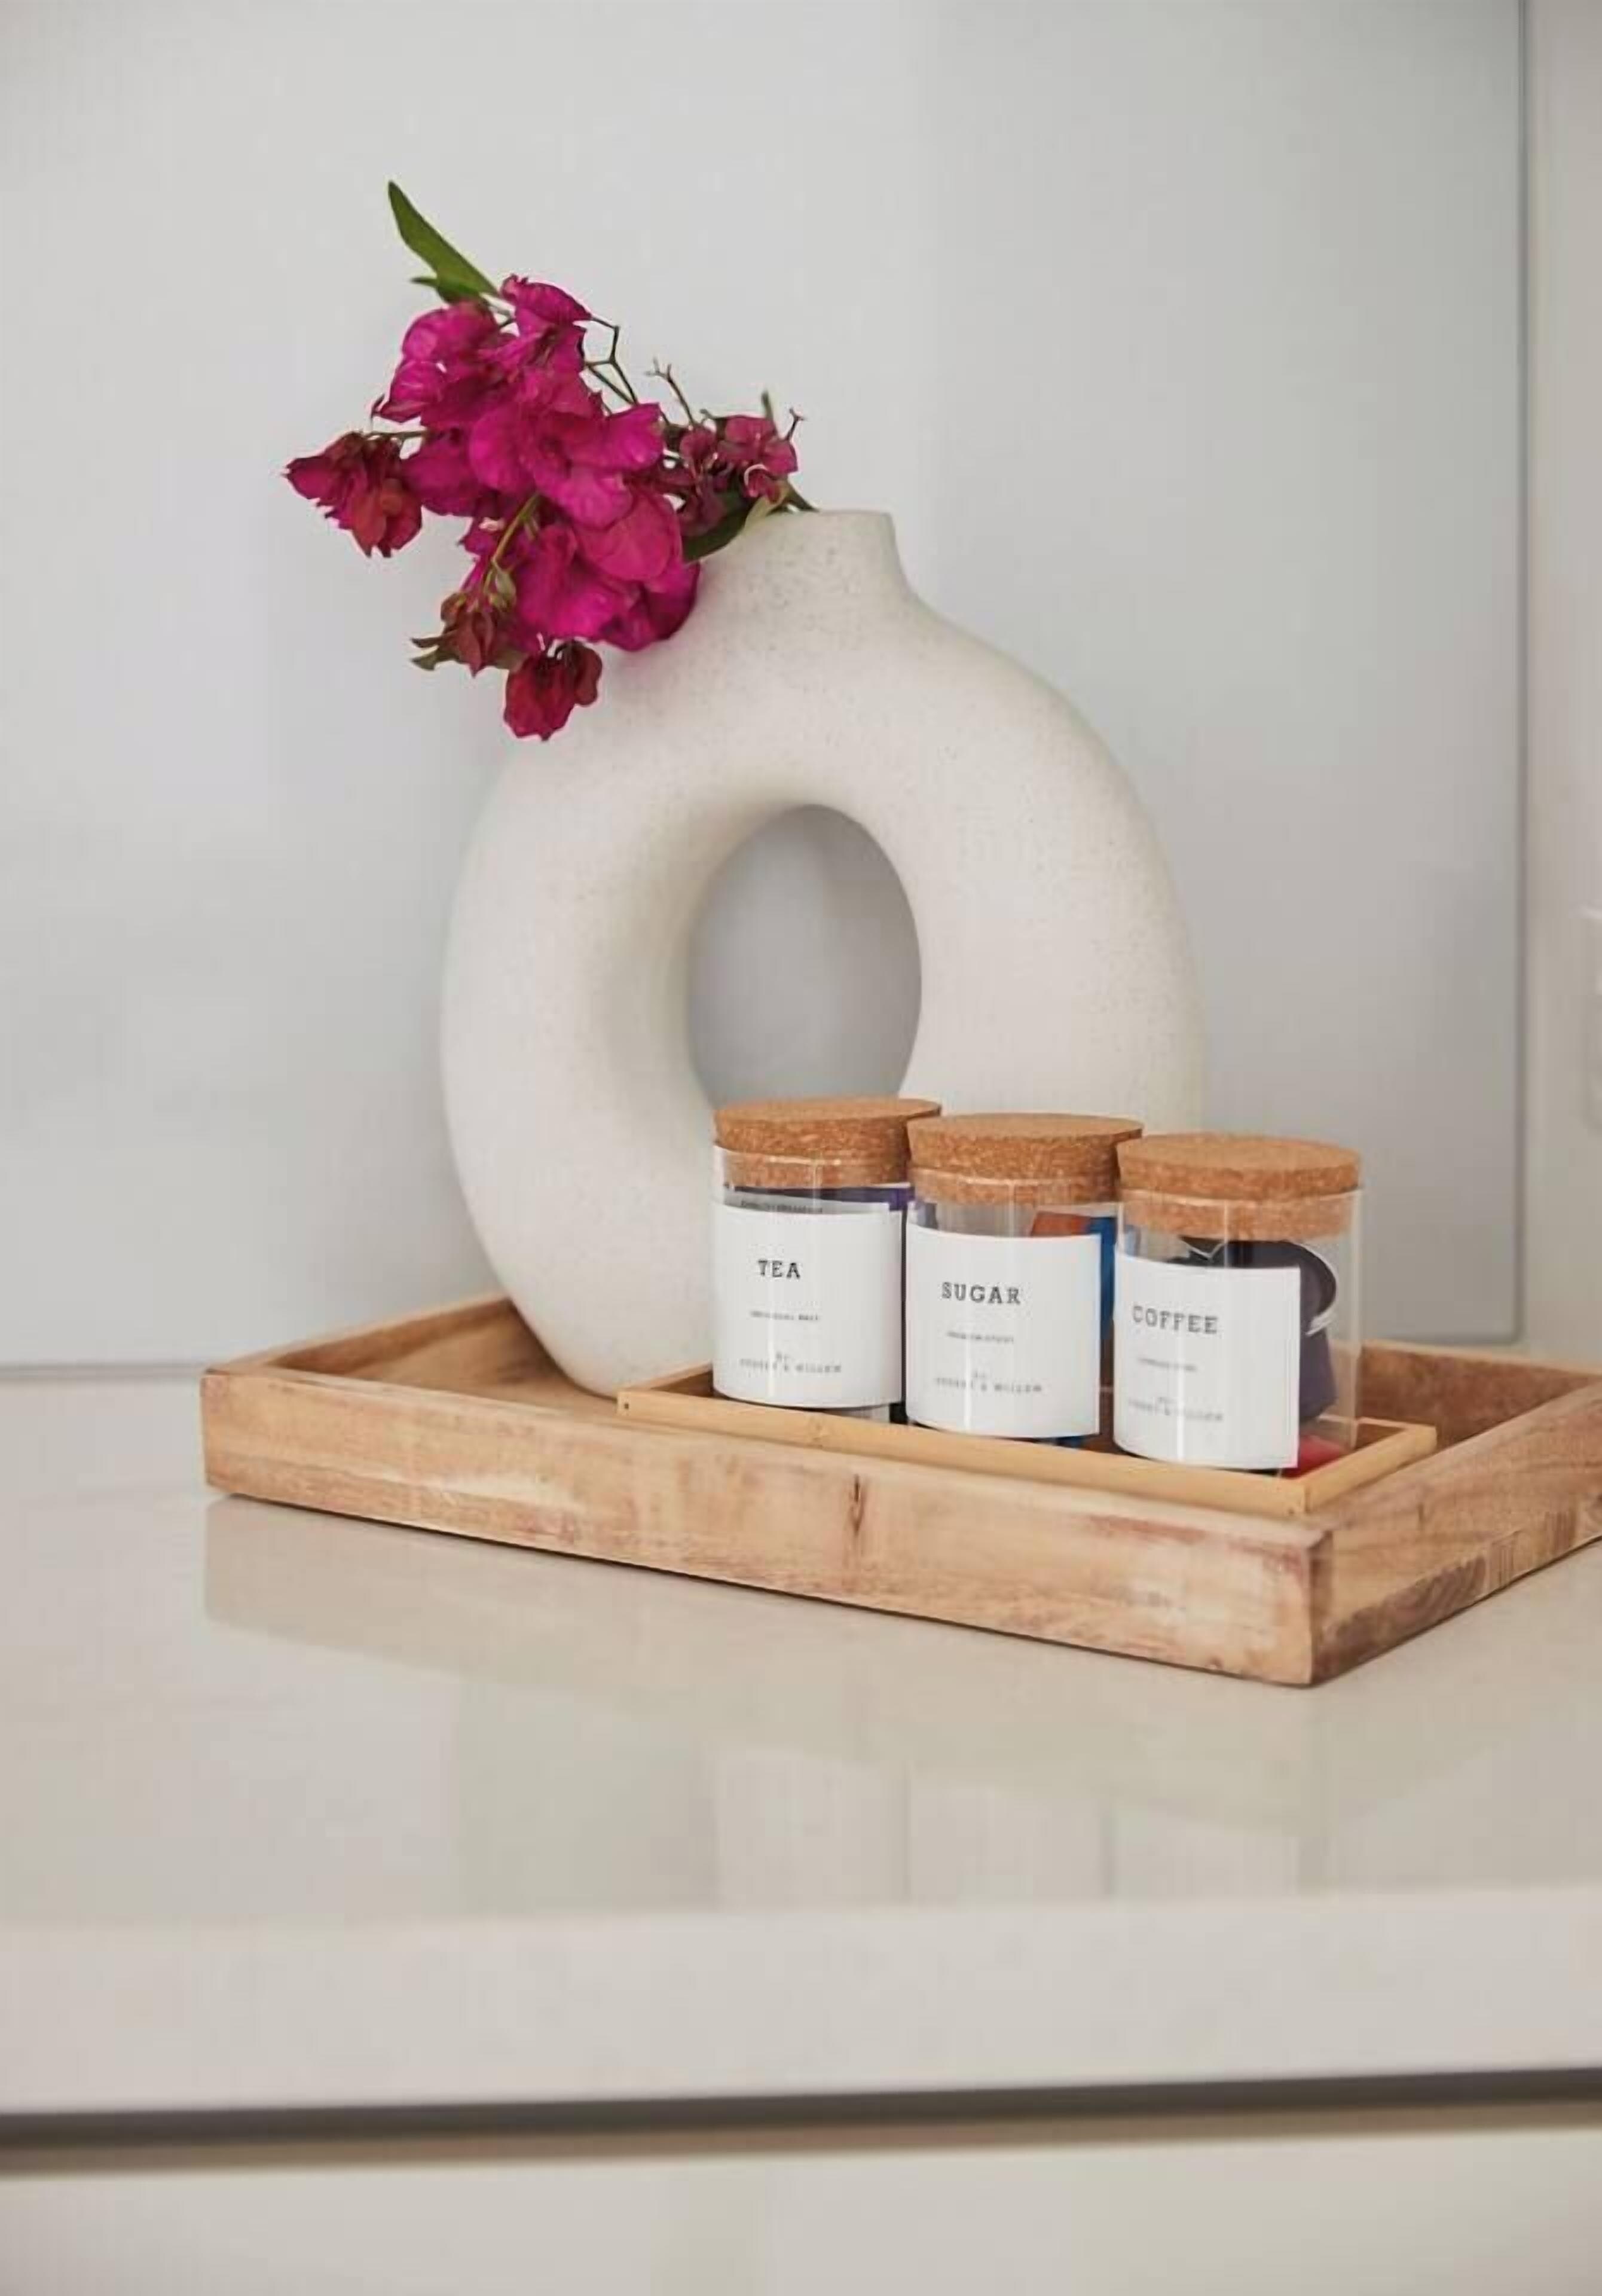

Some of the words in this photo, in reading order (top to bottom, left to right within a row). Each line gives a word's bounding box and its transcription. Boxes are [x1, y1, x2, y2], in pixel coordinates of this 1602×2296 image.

[757, 1259, 800, 1279] TEA
[942, 1282, 1020, 1305] SUGAR
[1133, 1305, 1218, 1334] COFFEE
